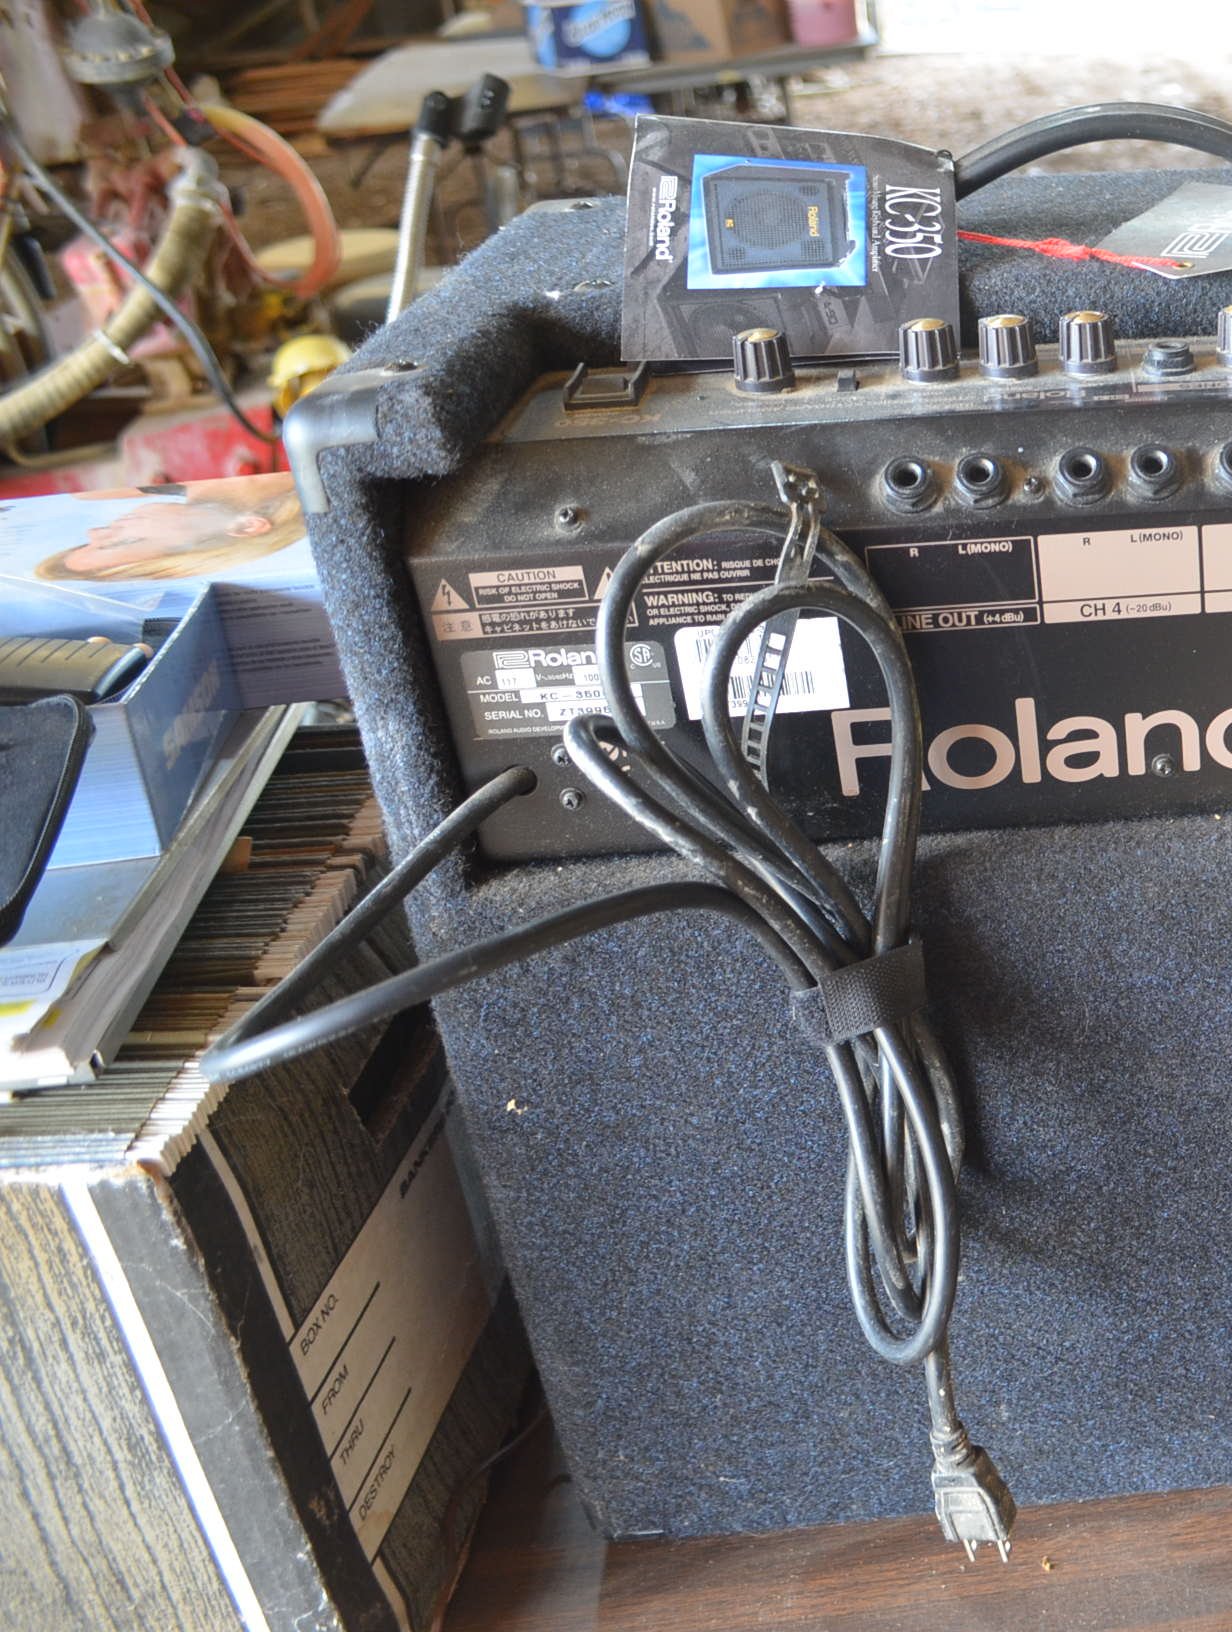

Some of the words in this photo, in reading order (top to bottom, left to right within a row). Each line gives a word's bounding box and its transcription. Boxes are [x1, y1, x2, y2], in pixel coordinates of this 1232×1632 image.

[885, 184, 943, 260] KC-350
[655, 199, 677, 261] Roland
[1083, 537, 1091, 546] R
[909, 548, 919, 557] R
[650, 558, 718, 574] TENTION:
[722, 560, 751, 569] RISQUE
[497, 570, 557, 583] CAUTION
[642, 574, 690, 584] LECTRIQUE
[691, 573, 702, 581] NE
[703, 571, 720, 580] PAS
[722, 569, 751, 579] OUVRIR
[479, 587, 498, 596] RISK
[498, 586, 511, 595] OF
[511, 584, 551, 593] ELECTRIC
[551, 582, 580, 591] SHOCK
[504, 594, 516, 602] DO
[517, 593, 534, 602] NOT
[535, 592, 559, 601] OPEN
[644, 591, 719, 607] WARNING:
[722, 594, 733, 602] TO
[646, 608, 659, 617] OR
[660, 606, 698, 615] ELECTRIC
[1080, 603, 1106, 617] CH
[1112, 602, 1122, 615] 4
[649, 616, 692, 626] APPLIANCE
[694, 615, 705, 623] TO
[938, 610, 979, 627] OUT
[528, 648, 597, 668] Rolan
[477, 675, 492, 686] AC
[480, 693, 519, 703] MODEL
[484, 709, 523, 720] SERIAL
[524, 708, 544, 719] NO.
[300, 1316, 325, 1357] BOX
[318, 1293, 341, 1327] NO.
[321, 1364, 350, 1416] FROM
[338, 1418, 366, 1467] THRU
[357, 1444, 398, 1522] DESTROY
